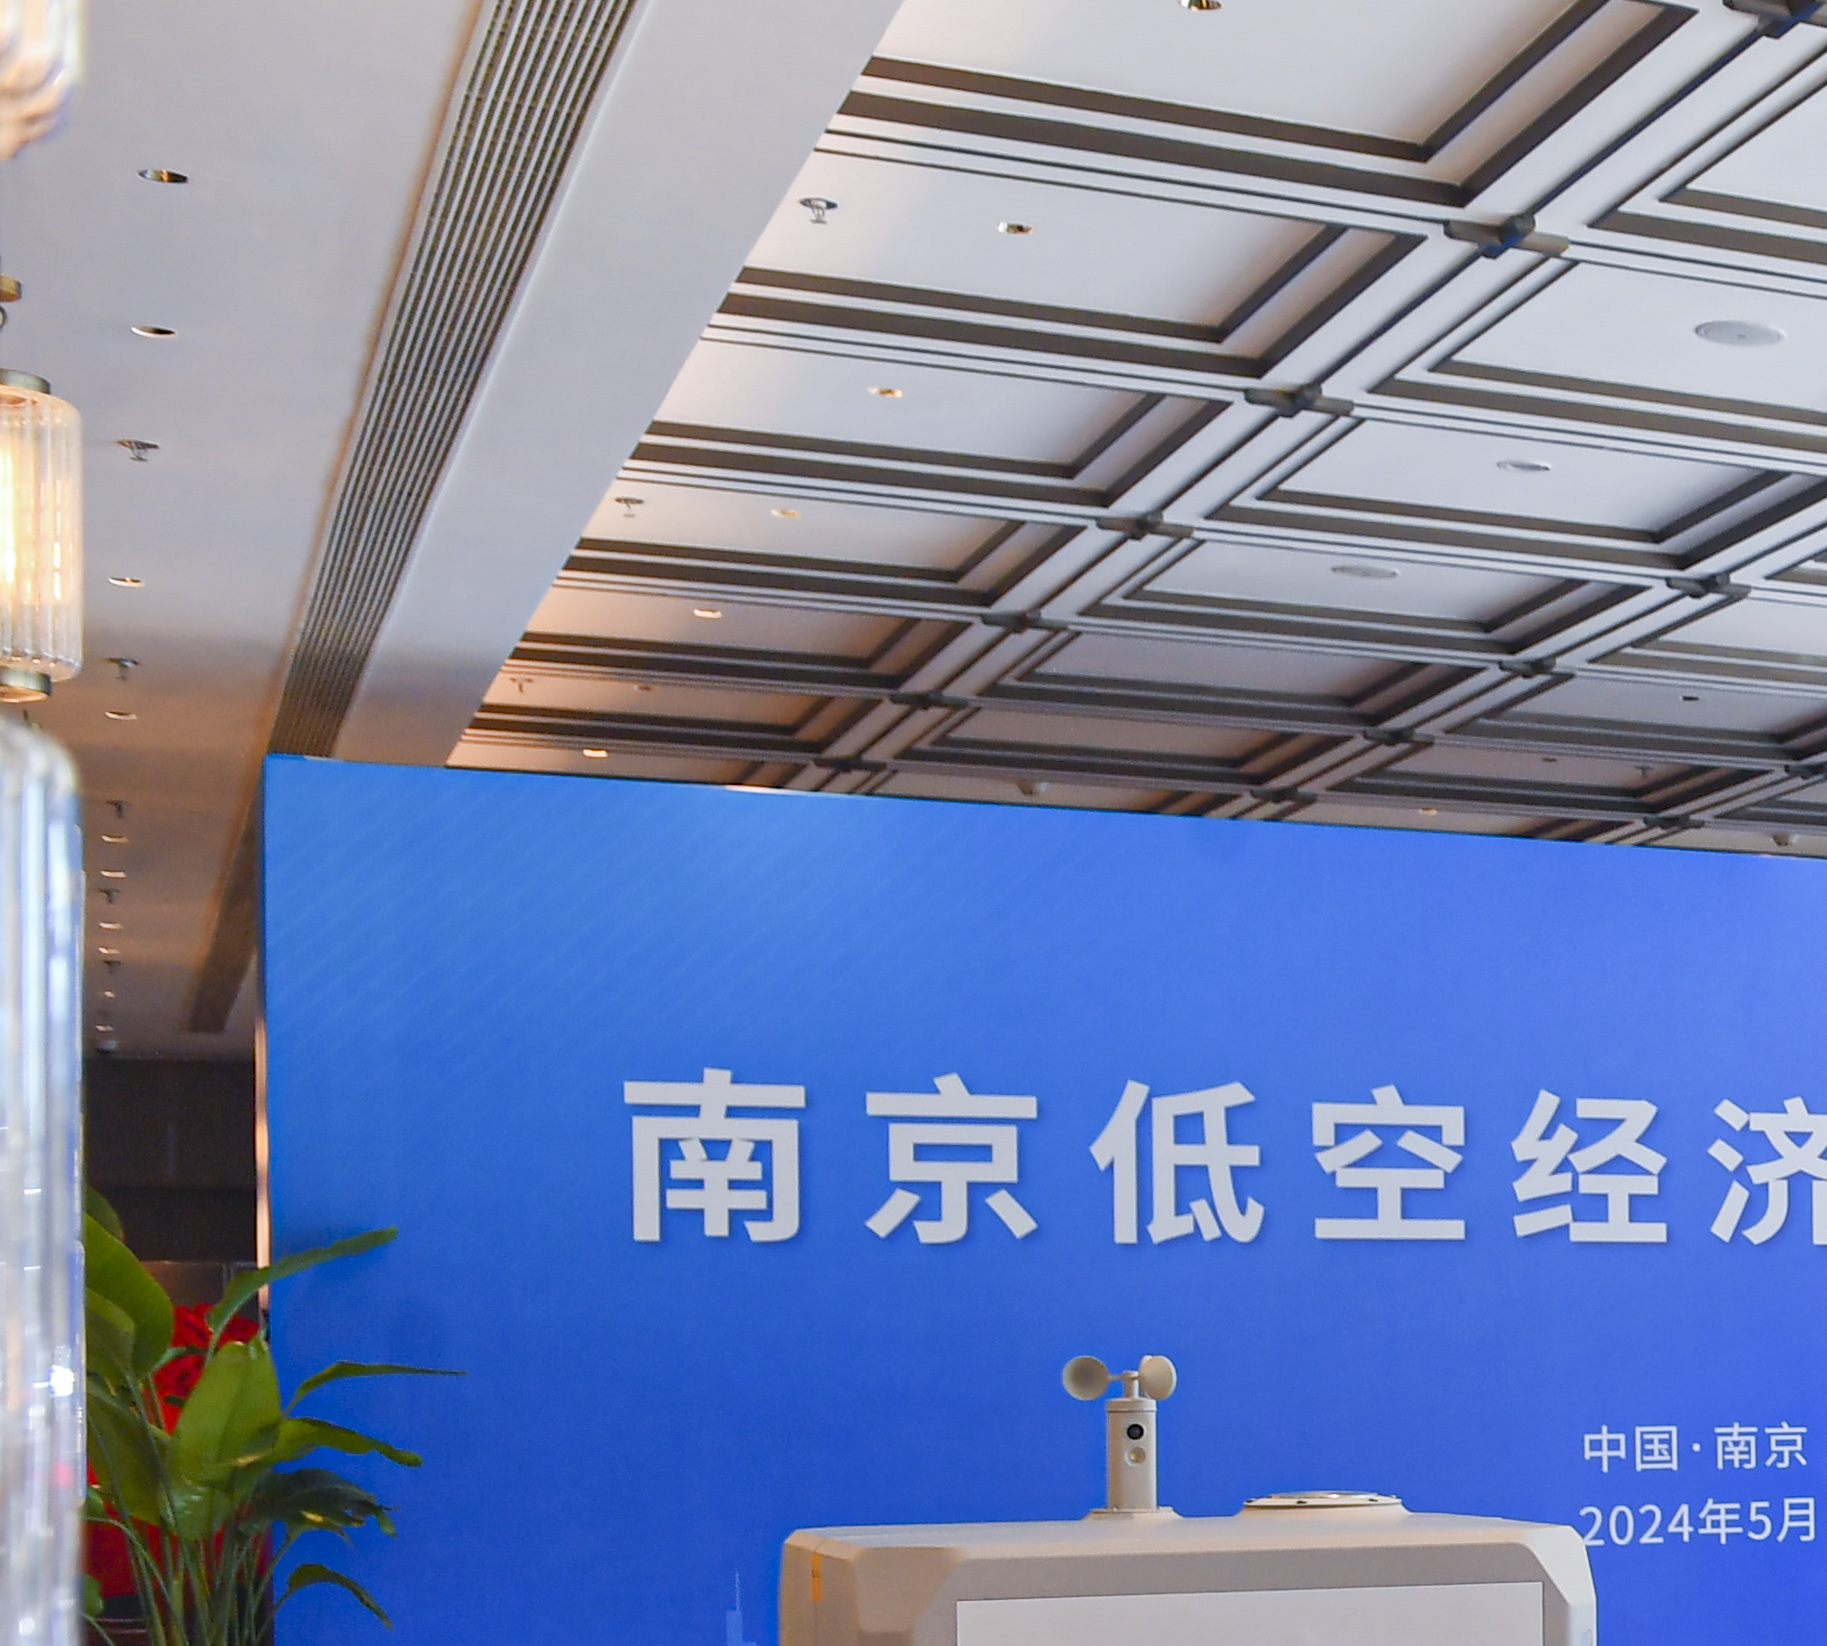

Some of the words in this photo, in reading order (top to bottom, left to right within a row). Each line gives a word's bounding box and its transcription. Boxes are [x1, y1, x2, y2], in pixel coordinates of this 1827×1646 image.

[1583, 1421, 1808, 1474] 中国·南京
[1579, 1497, 1816, 1547] 2024年5月
